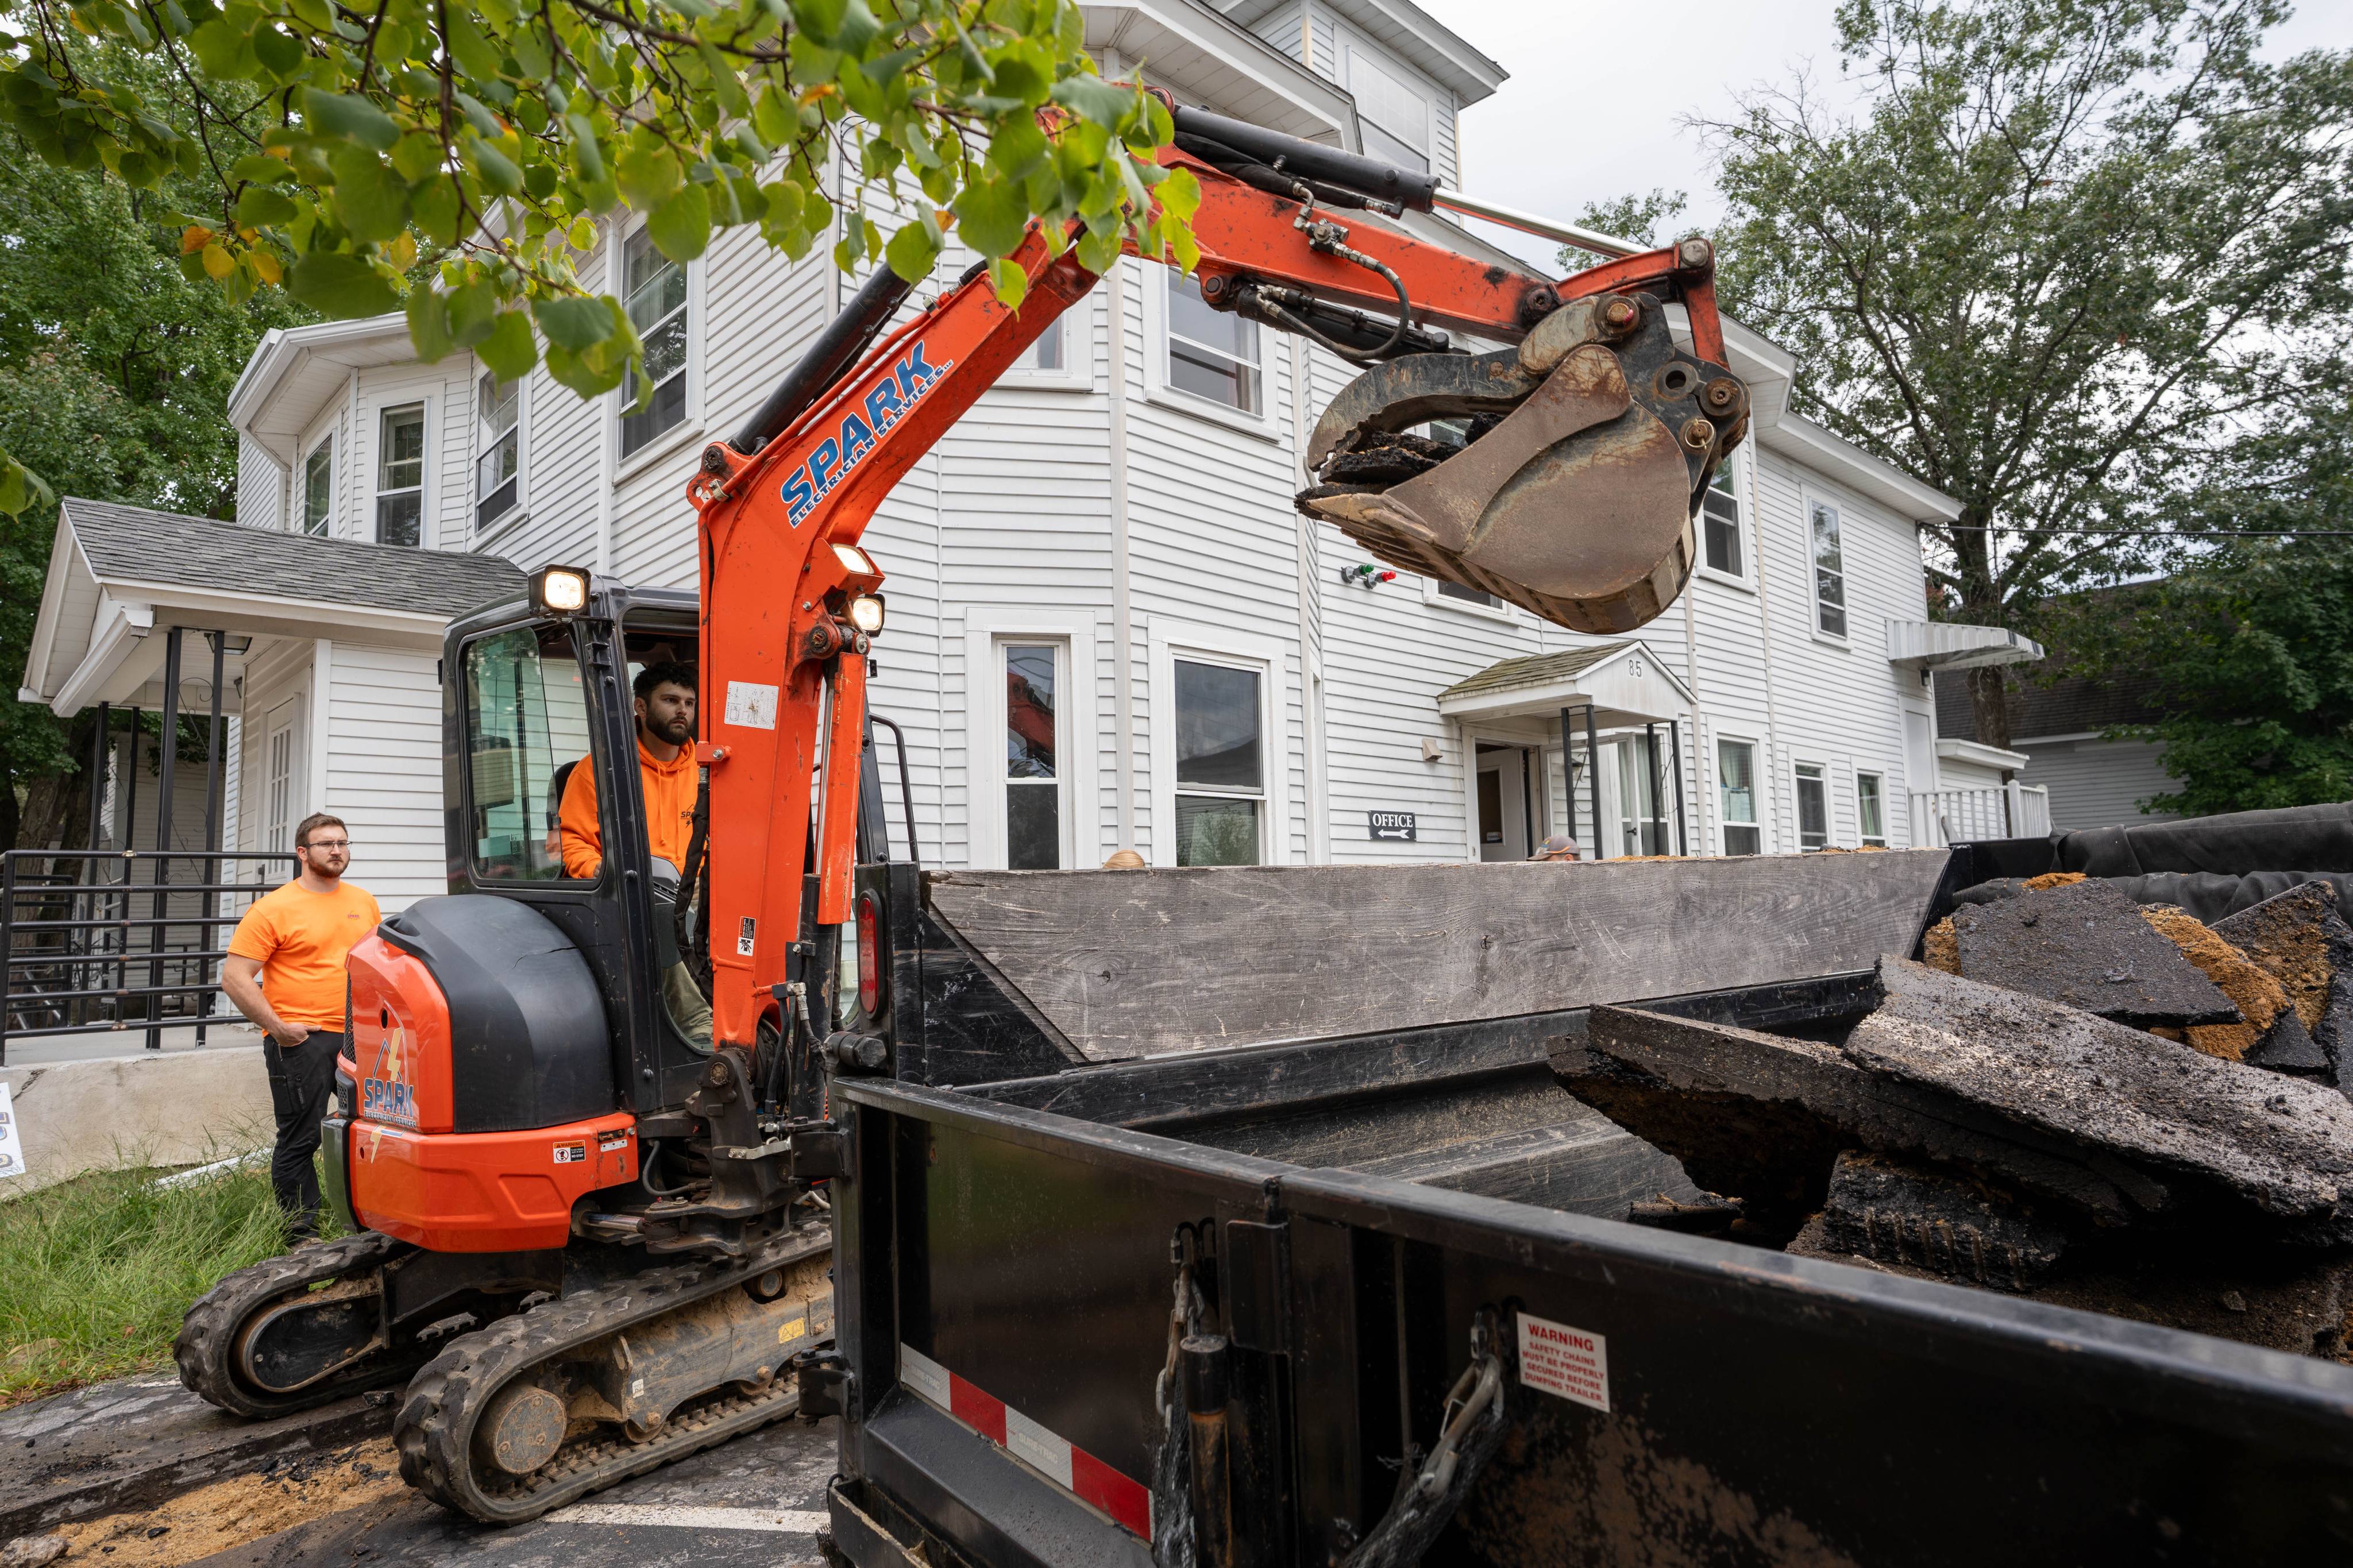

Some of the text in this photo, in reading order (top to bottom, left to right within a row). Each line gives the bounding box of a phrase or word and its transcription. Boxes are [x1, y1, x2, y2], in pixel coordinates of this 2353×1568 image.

[781, 340, 934, 519] SPARK
[789, 360, 954, 528] ELECTRICIAN SERVICES LLC
[1629, 659, 1642, 677] 85
[1372, 813, 1413, 827] OFFICE
[364, 1077, 414, 1118] SPARK
[364, 1110, 416, 1127] ELECTRICIAN SERVICES
[1528, 1323, 1594, 1351] WARNING
[1523, 1351, 1604, 1380] MUST BE PROPERLY
[1529, 1342, 1595, 1367] SAFETY CHAINS
[1525, 1373, 1604, 1403] DUMPING TRAILER.
[1527, 1362, 1601, 1391] SECURED BEFORE
[1019, 1432, 1058, 1463] SURE-TRAC
